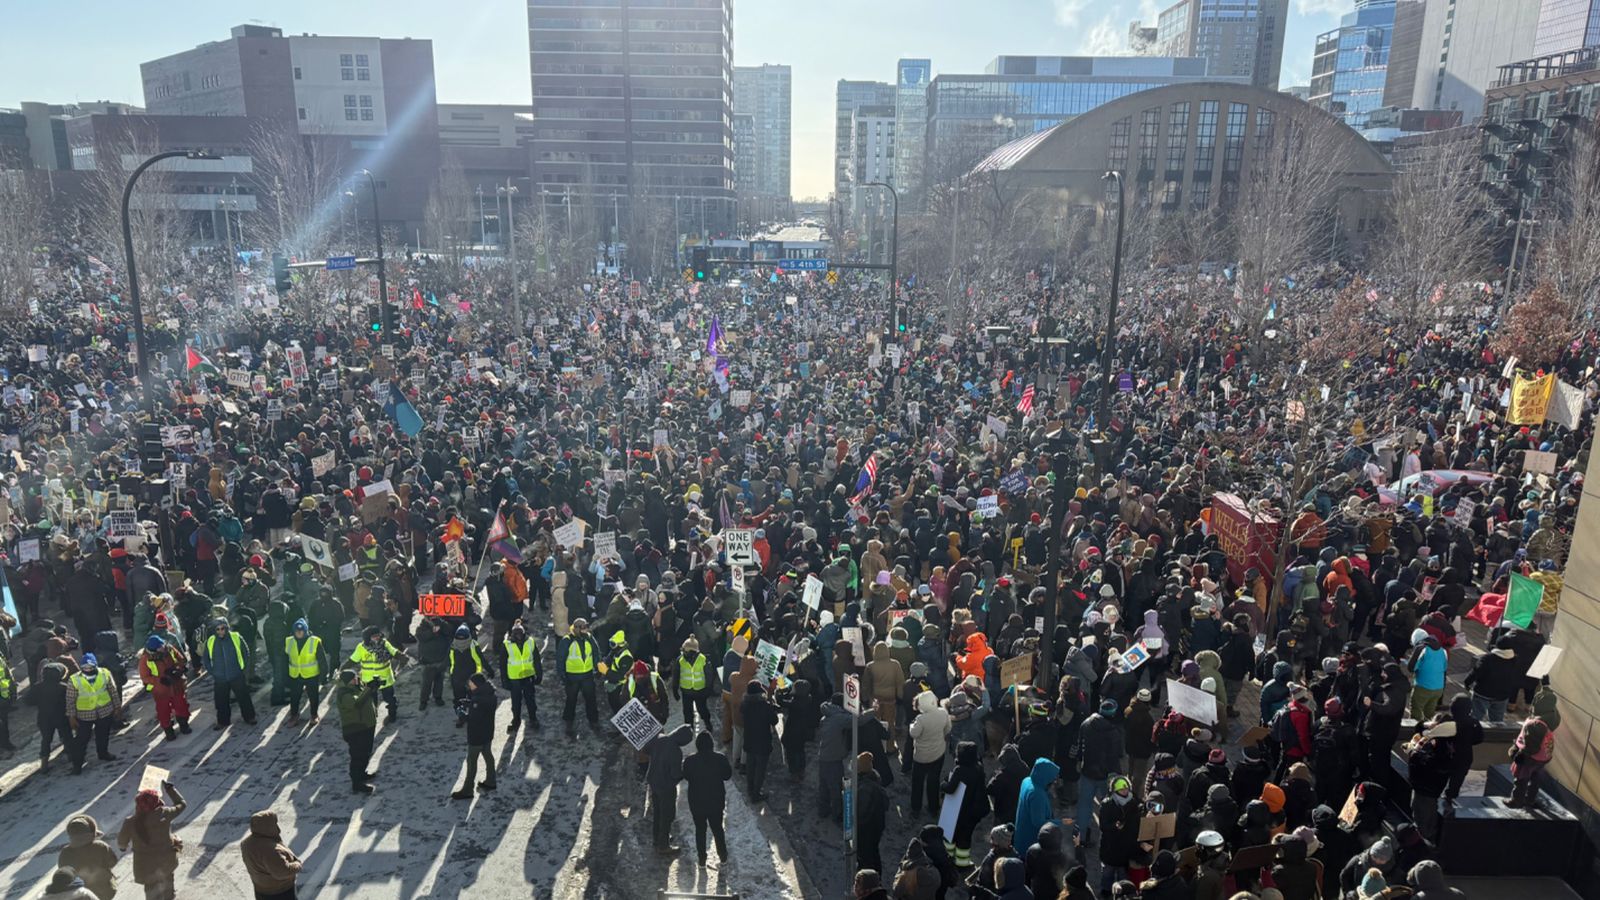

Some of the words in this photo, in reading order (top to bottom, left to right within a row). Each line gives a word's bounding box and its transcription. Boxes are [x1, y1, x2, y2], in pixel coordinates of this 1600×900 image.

[230, 371, 249, 383] GTFO
[729, 532, 749, 541] ONE
[1215, 507, 1249, 546] WELLS
[728, 543, 750, 551] WAY
[419, 595, 440, 615] ICE
[443, 597, 464, 615] OUT
[763, 654, 781, 677] NOW
[618, 705, 648, 734] STRIKE
[628, 716, 658, 744] RACISM
